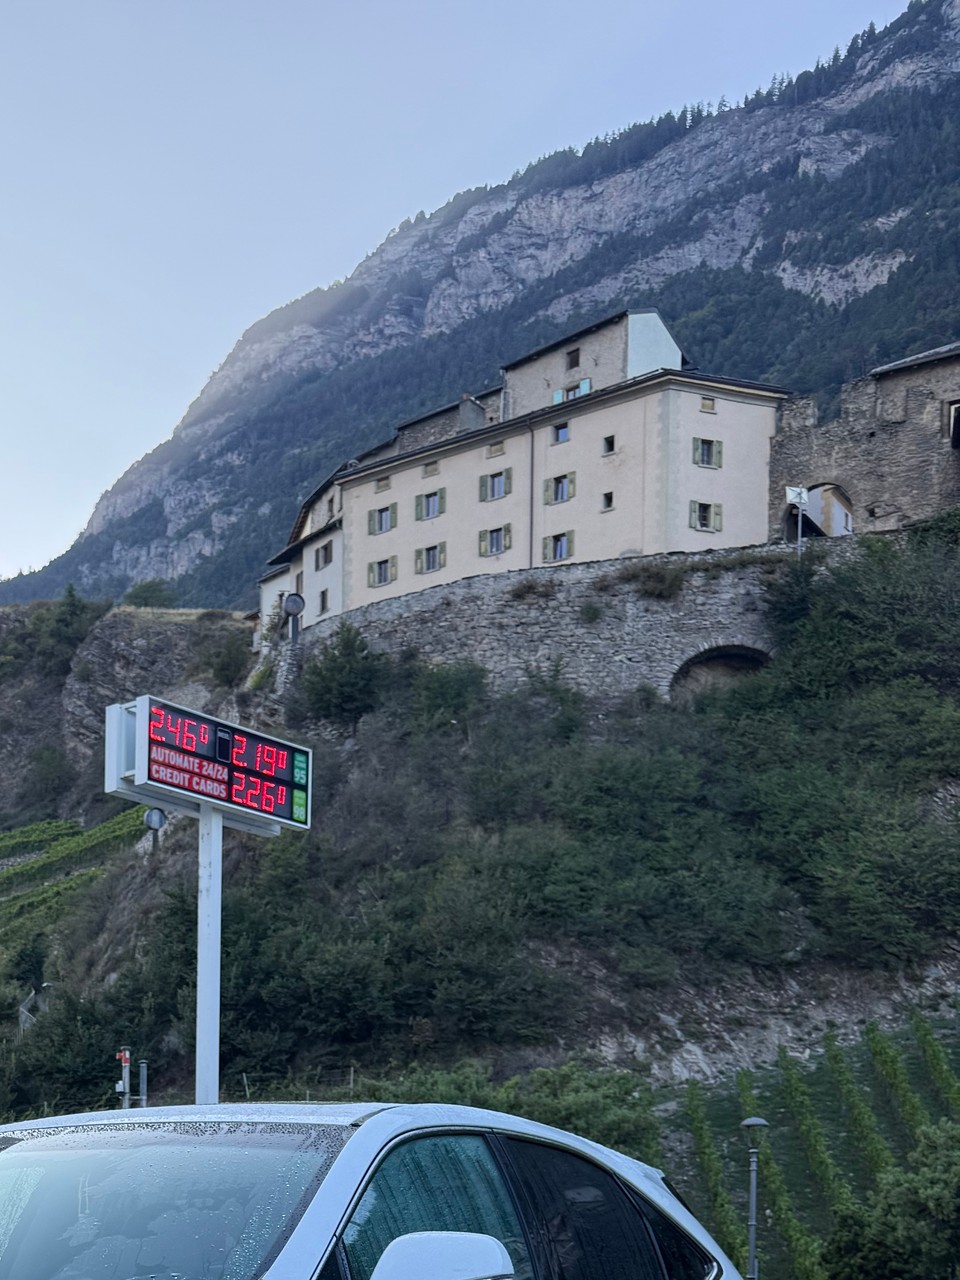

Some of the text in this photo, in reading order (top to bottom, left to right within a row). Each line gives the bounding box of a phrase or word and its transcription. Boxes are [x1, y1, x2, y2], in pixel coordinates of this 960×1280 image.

[151, 746, 228, 781] AUTOMATE 24/24
[294, 768, 307, 785] 95
[152, 765, 227, 798] CREDIT CARDS
